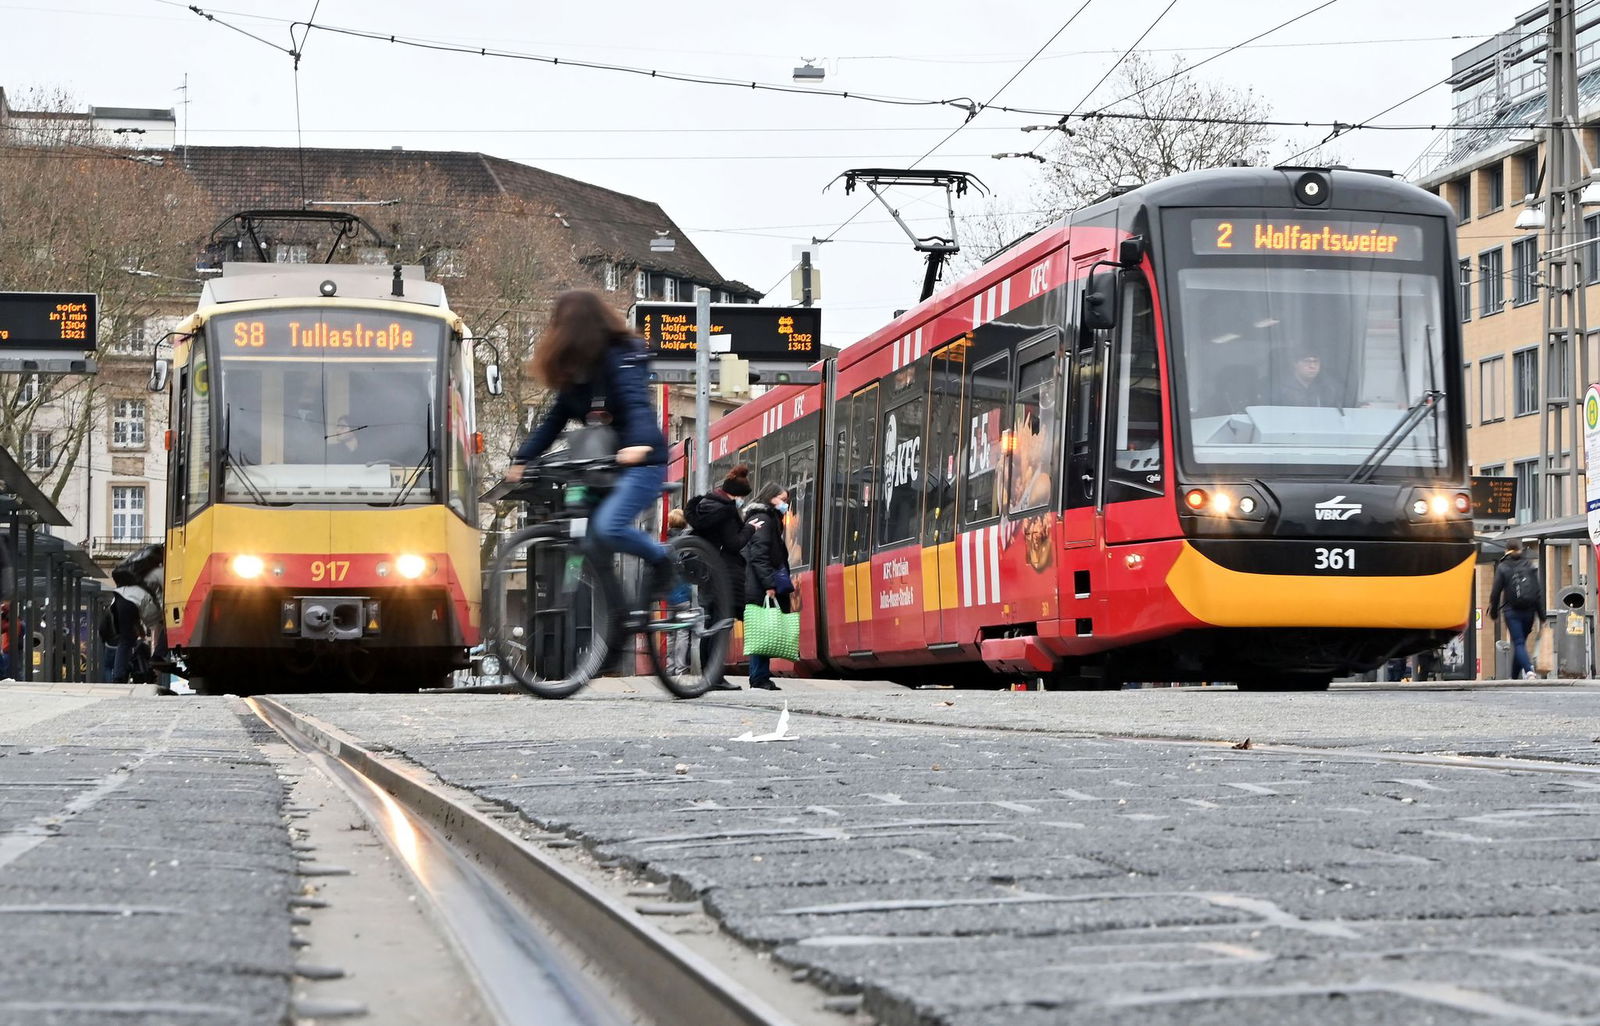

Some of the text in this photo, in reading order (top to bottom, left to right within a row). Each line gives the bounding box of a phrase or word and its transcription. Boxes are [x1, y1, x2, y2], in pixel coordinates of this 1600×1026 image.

[1217, 222, 1398, 253] 2 Wolfartsweier
[1028, 260, 1049, 298] KFC
[56, 303, 87, 312] sofort
[49, 312, 60, 320] in
[69, 312, 87, 320] min
[644, 314, 686, 323] 4 Tivoli
[61, 321, 86, 329] 13:04
[644, 323, 724, 333] 2 Wolfartsier
[61, 330, 86, 339] 13:21
[234, 321, 414, 350] S8 Tullastraße
[644, 332, 812, 342] 3 Tivoli 13:02
[788, 342, 812, 351] 13:13
[793, 393, 805, 419] KFC
[895, 436, 920, 487] KFC
[1315, 509, 1342, 520] VBK
[1314, 547, 1355, 570] 361
[310, 561, 350, 581] 917
